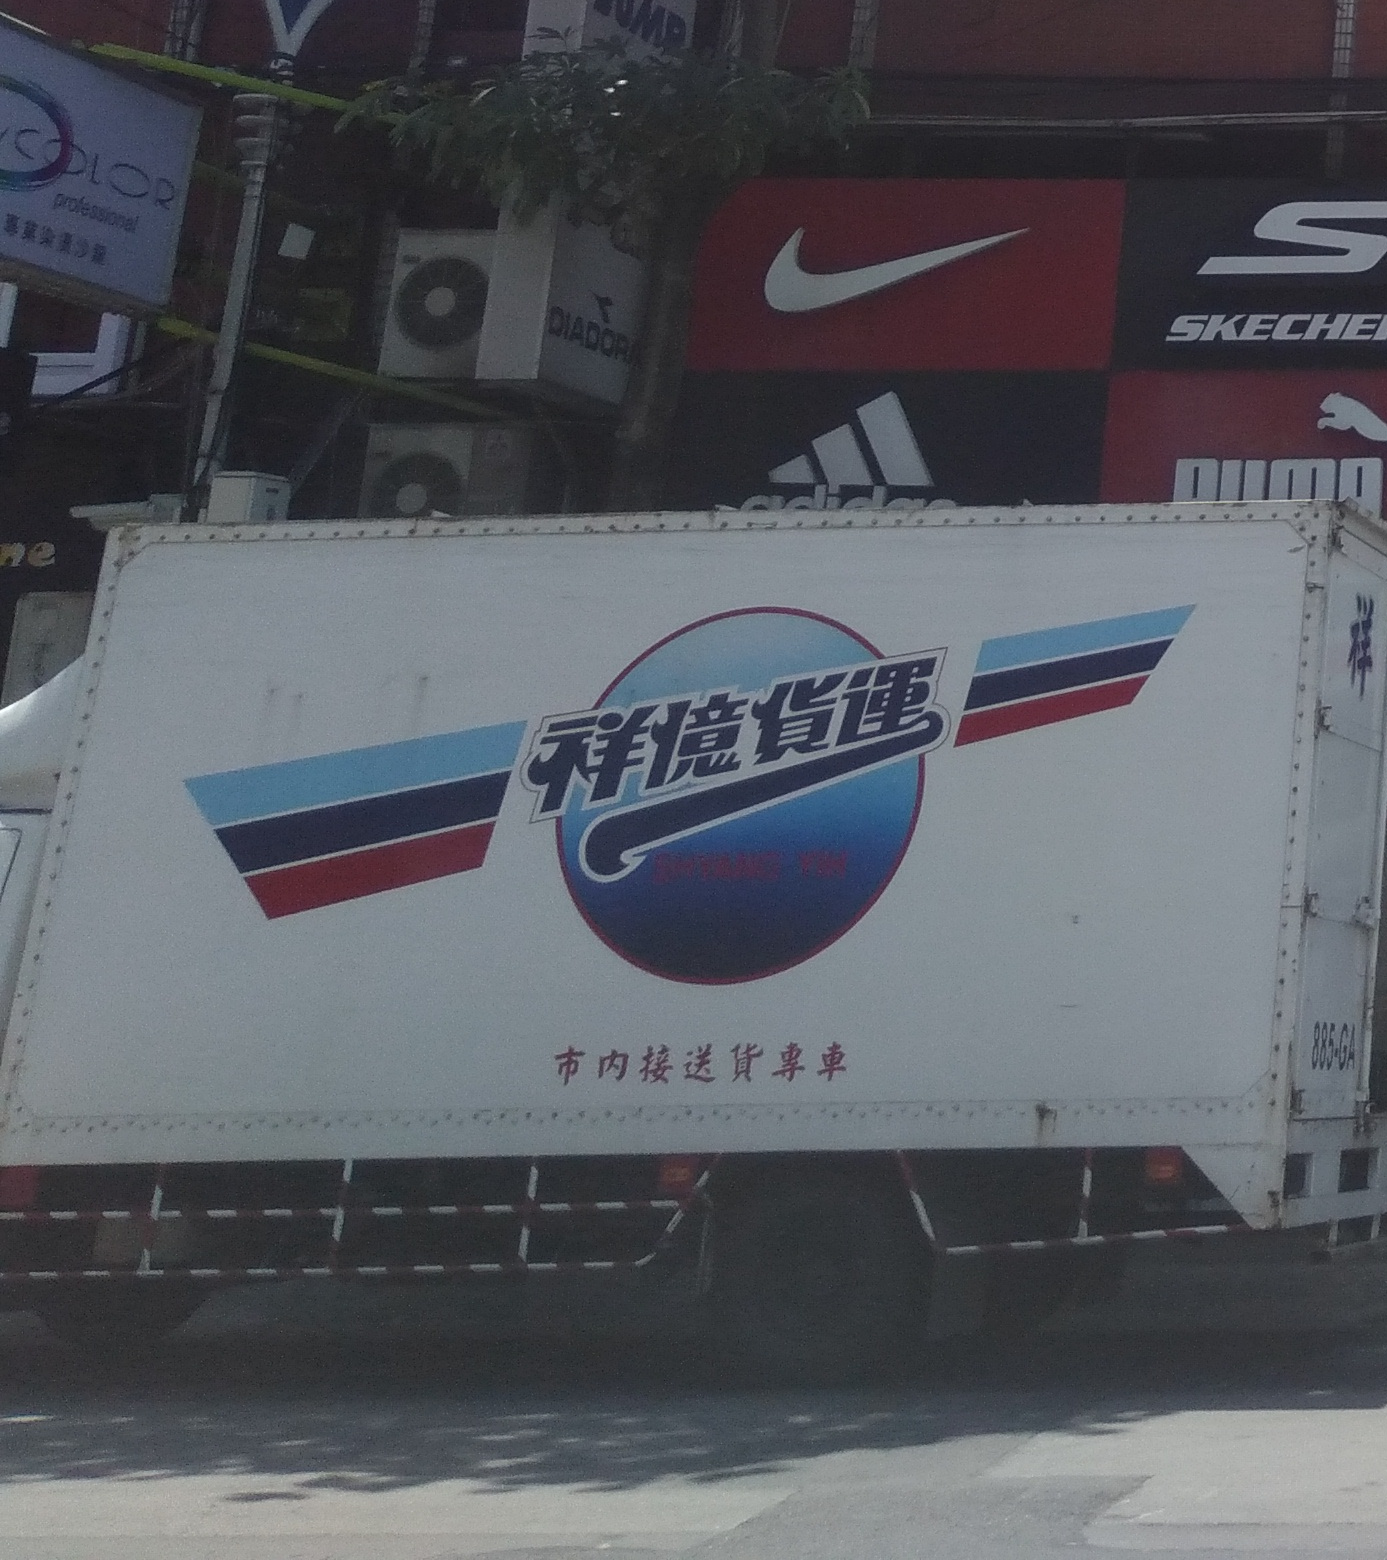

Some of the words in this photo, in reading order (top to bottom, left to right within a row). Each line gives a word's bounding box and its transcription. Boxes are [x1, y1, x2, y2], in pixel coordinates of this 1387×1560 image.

[554, 1042, 848, 1085] 市內接送貨專車
[1311, 1020, 1356, 1071] 885-GA
